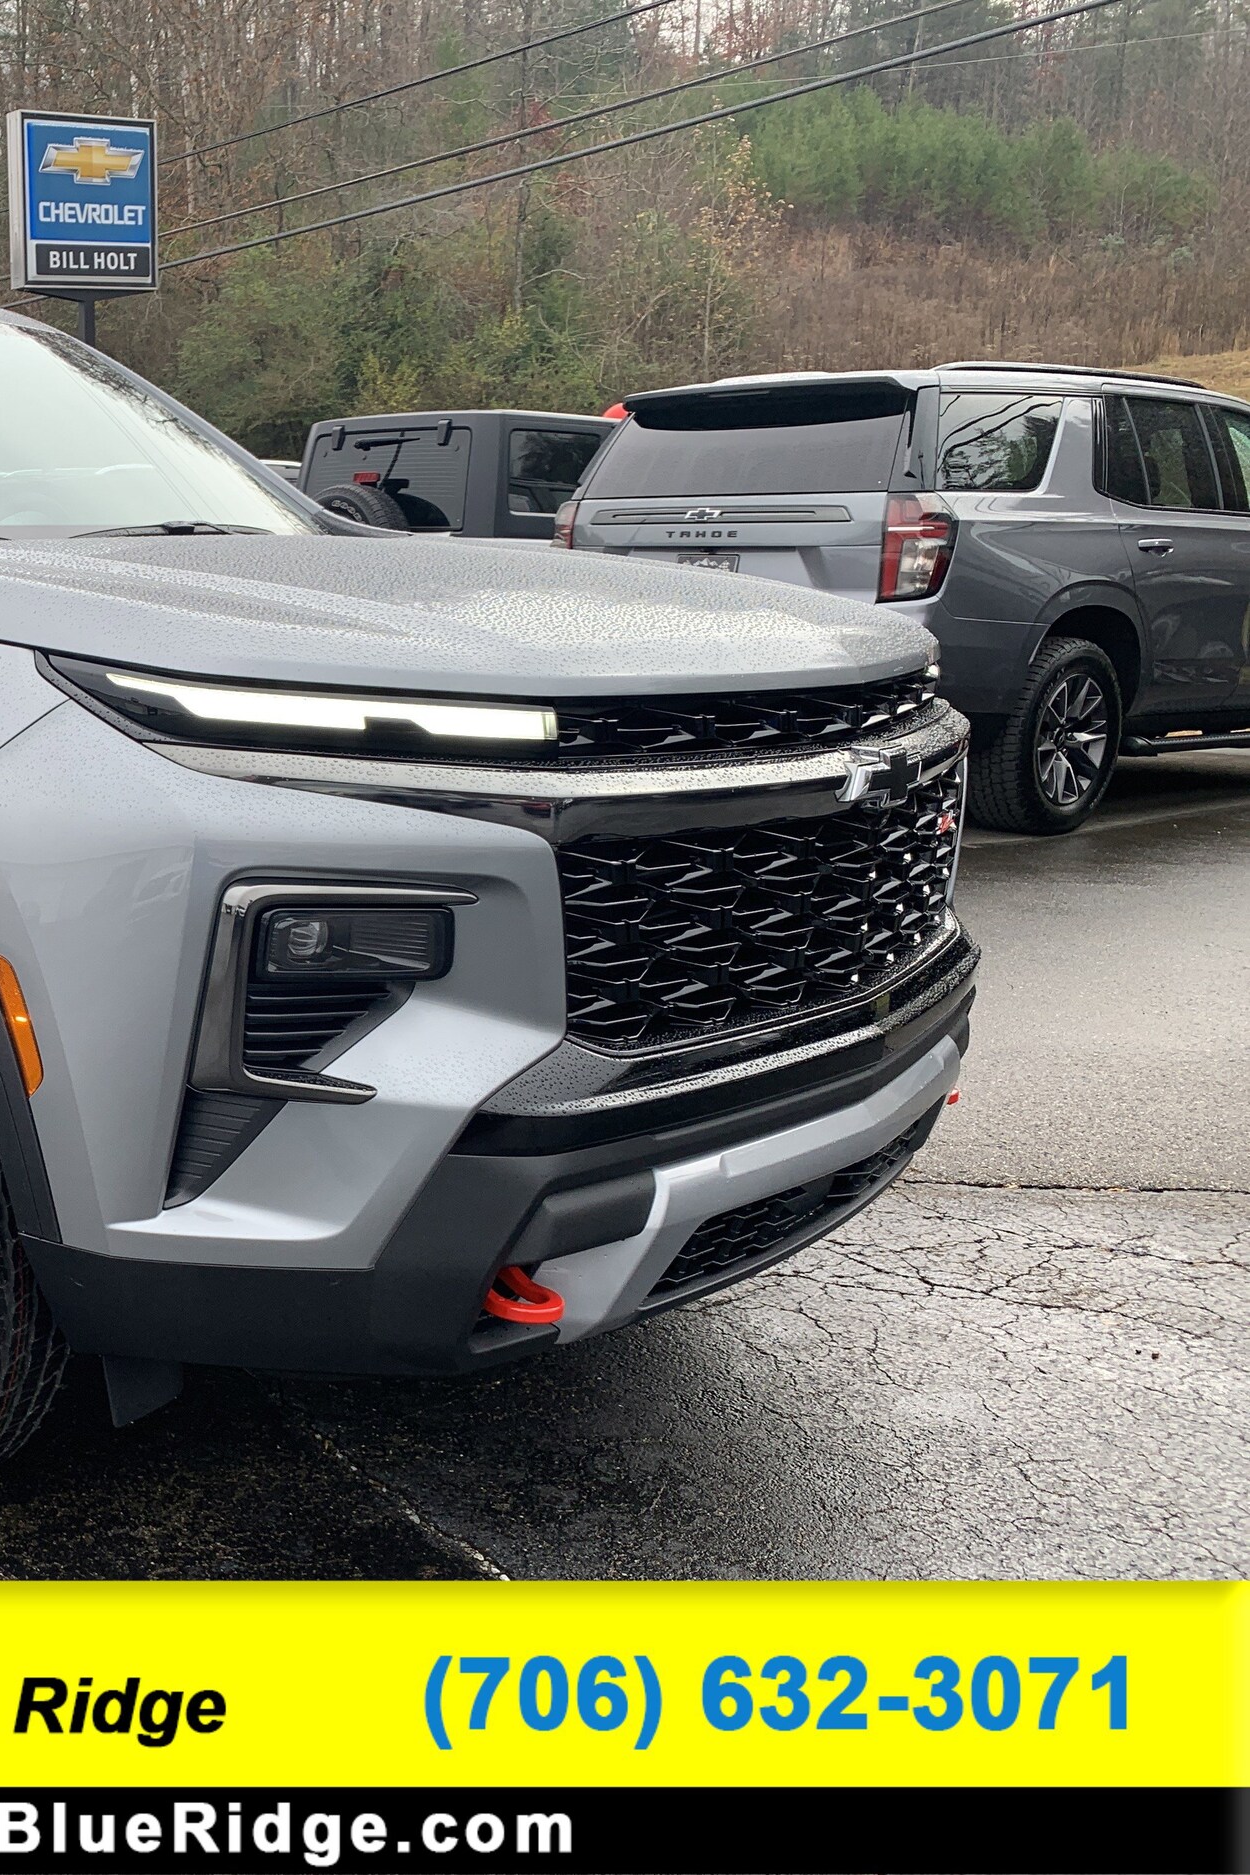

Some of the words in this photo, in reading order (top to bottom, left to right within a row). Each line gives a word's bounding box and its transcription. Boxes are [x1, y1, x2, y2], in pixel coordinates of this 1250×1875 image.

[38, 201, 146, 226] CHEVROLET
[49, 251, 90, 269] BILL
[93, 252, 137, 270] HOLT
[665, 530, 738, 539] TAHOE
